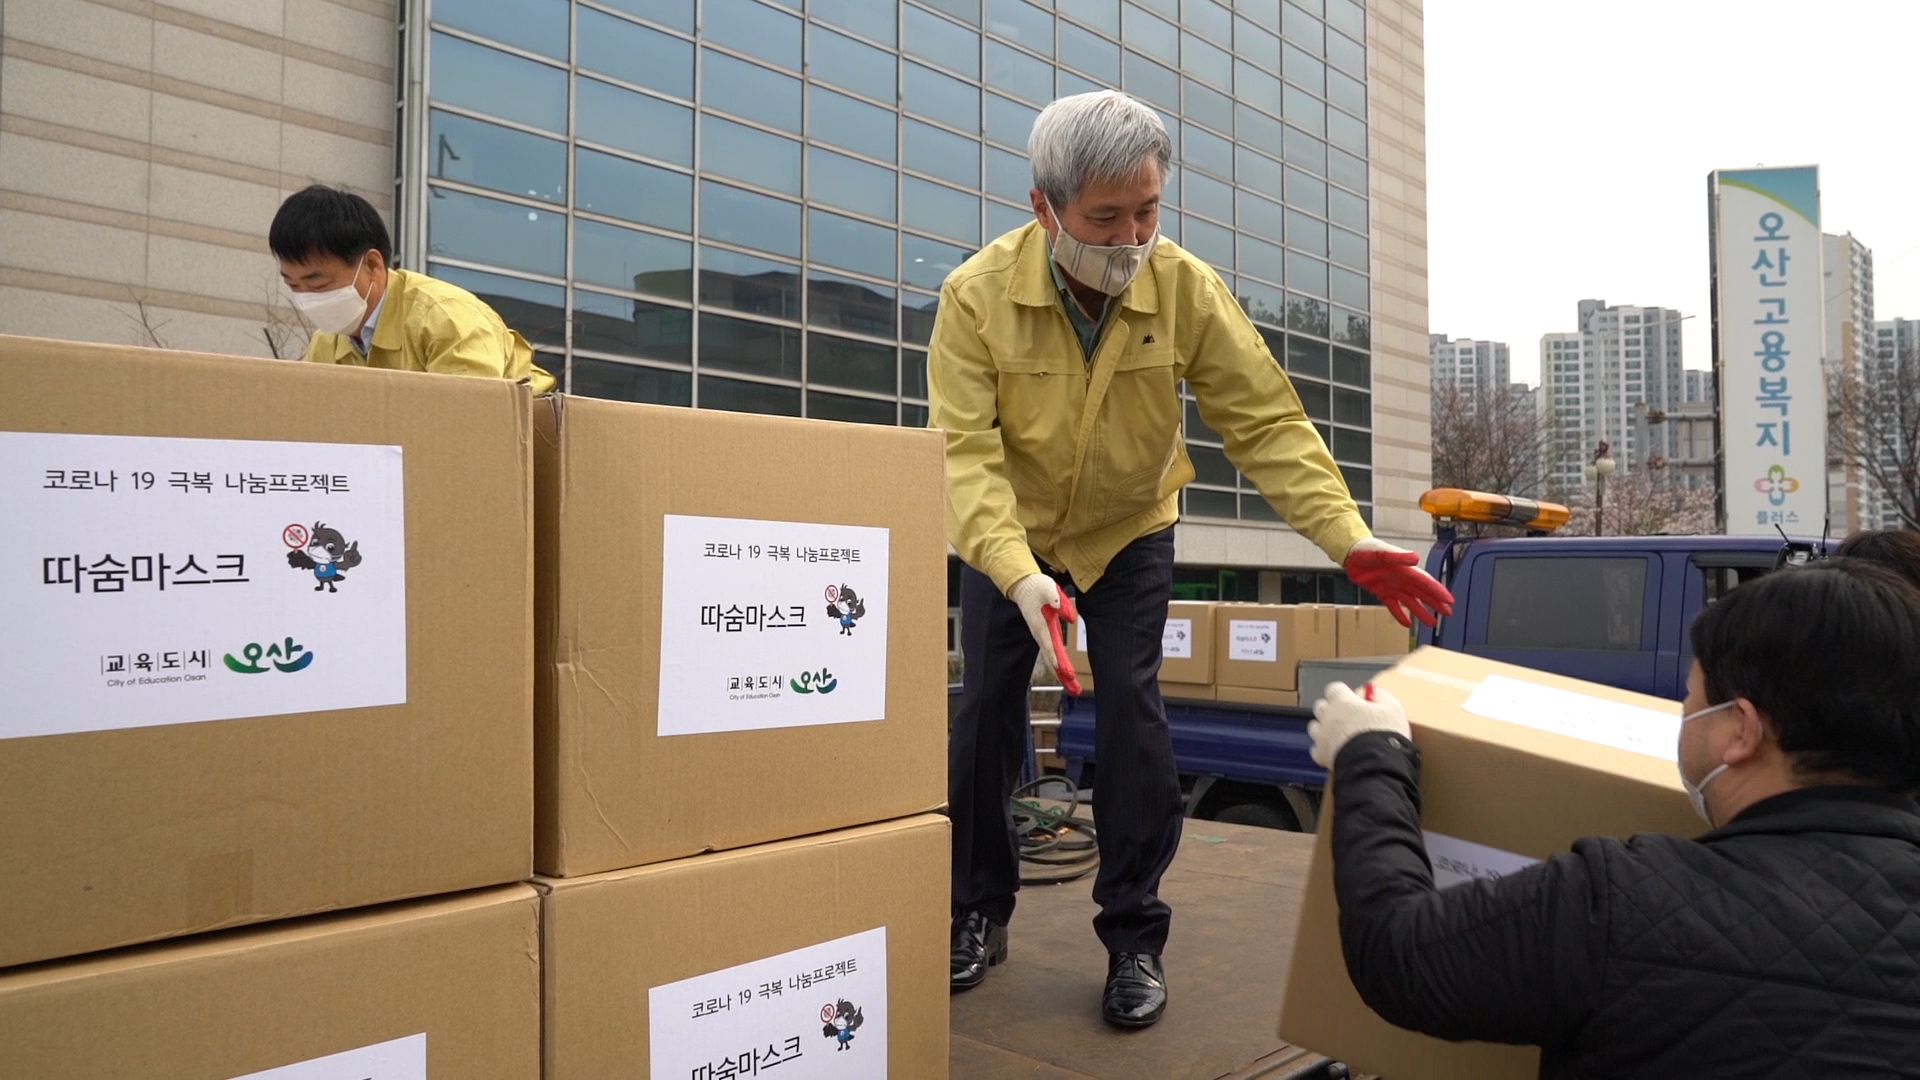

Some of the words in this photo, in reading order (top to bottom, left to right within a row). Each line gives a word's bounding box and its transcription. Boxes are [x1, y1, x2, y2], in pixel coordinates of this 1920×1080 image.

[1751, 212, 1792, 456] 오산고용복지
[44, 470, 118, 492] 코로나
[132, 472, 154, 489] 19
[168, 472, 213, 493] 극복
[226, 473, 349, 494] 나눔프로젝트
[1756, 510, 1800, 525] 플러스
[704, 543, 741, 560] 코로나
[749, 545, 760, 558] 19
[767, 546, 790, 561] 극복
[797, 547, 860, 563] 나눔프로젝트
[44, 553, 249, 593] 따숨마스크
[702, 604, 806, 632] 따숨마스크
[106, 650, 206, 672] 교육도시
[224, 637, 313, 674] 오산
[107, 679, 125, 687] City
[127, 677, 136, 685] of
[138, 674, 182, 685] Education
[184, 673, 206, 682] Osan
[729, 675, 782, 690] 교육도시
[790, 668, 837, 694] 오산
[692, 994, 731, 1018] 코로나
[739, 989, 751, 1005] 19
[759, 980, 782, 999] 극복
[789, 959, 857, 990] 나눔프로젝트
